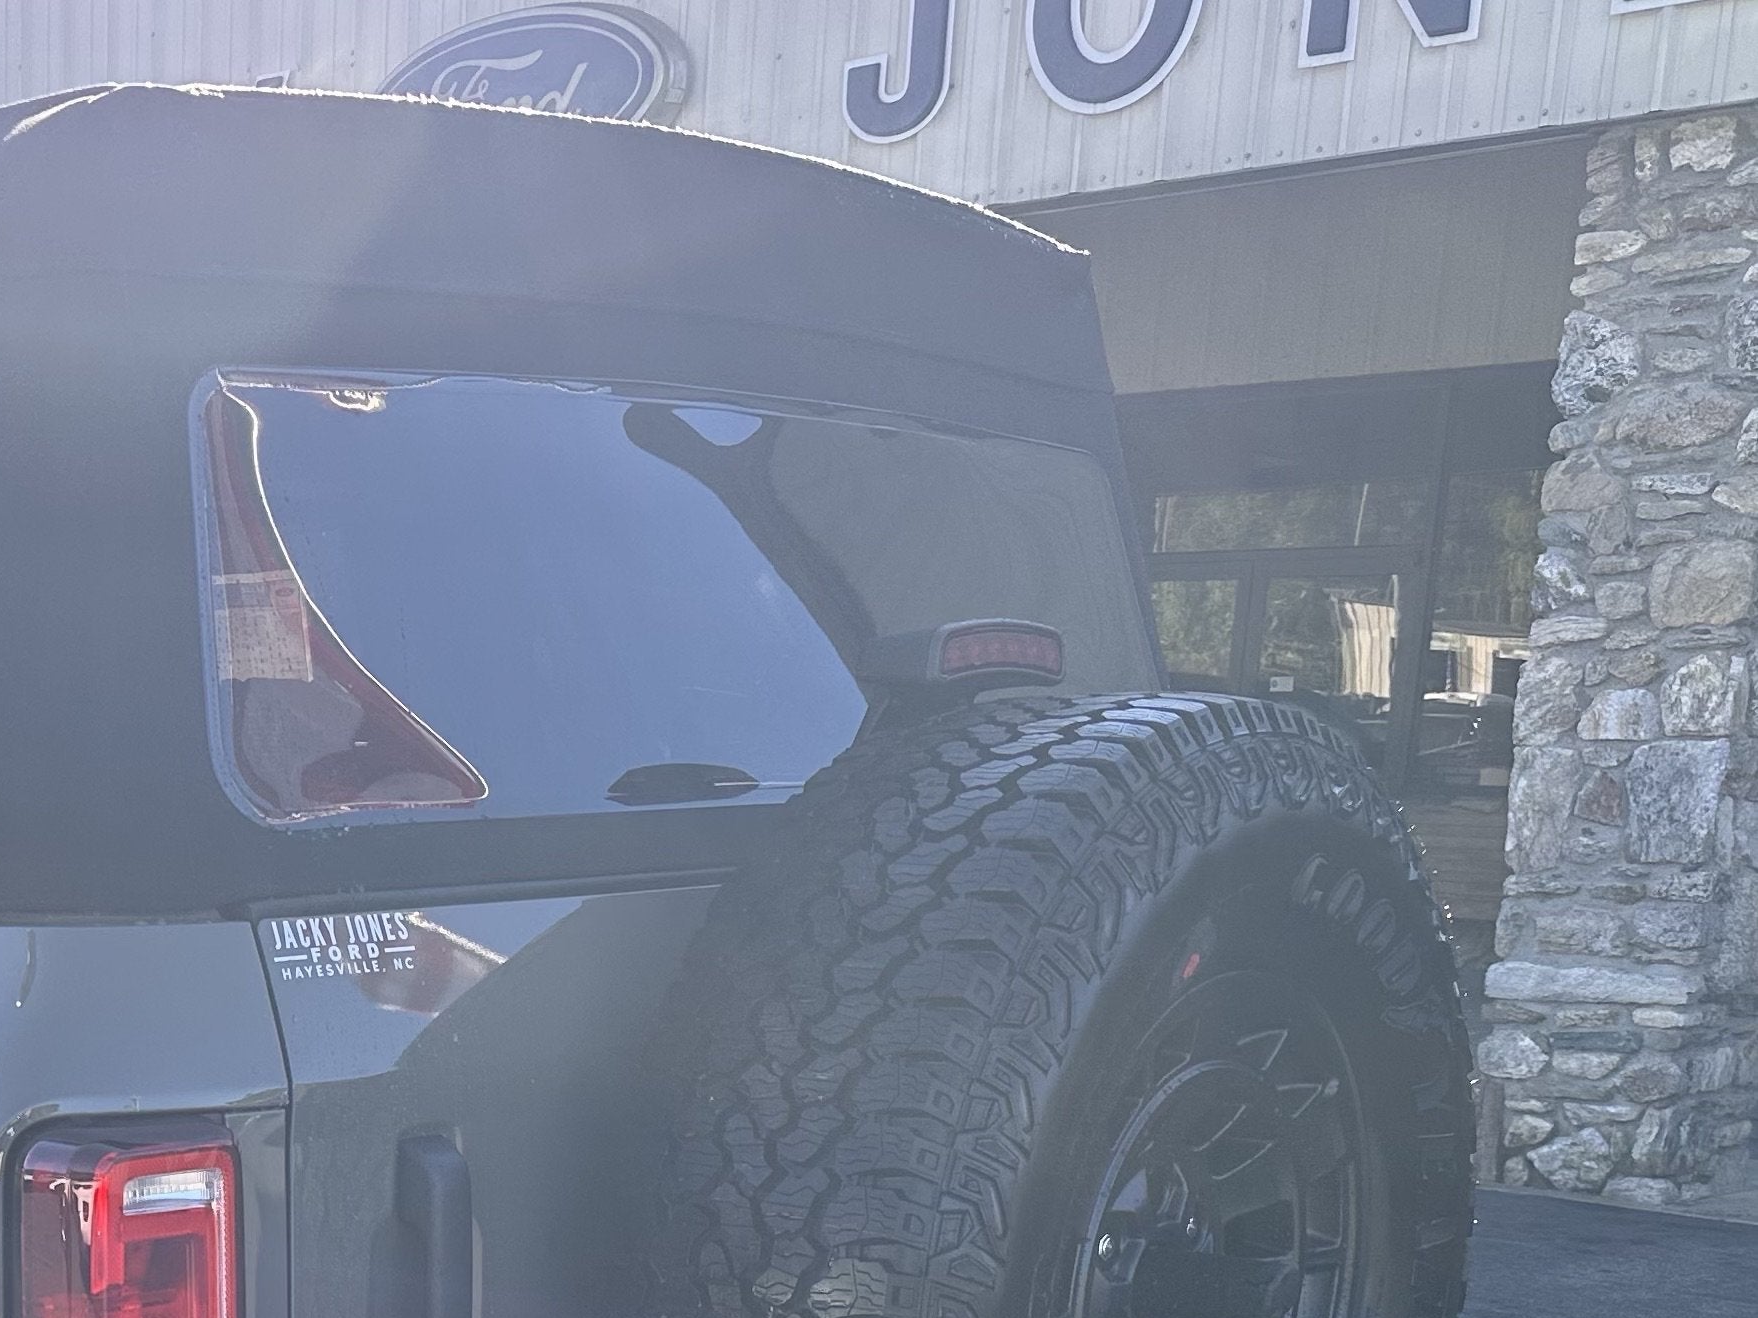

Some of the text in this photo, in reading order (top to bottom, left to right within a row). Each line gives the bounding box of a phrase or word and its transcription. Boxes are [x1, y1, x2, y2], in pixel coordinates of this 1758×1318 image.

[271, 912, 409, 950] JACKY JONES
[310, 942, 380, 963] FORD
[393, 957, 415, 971] NC
